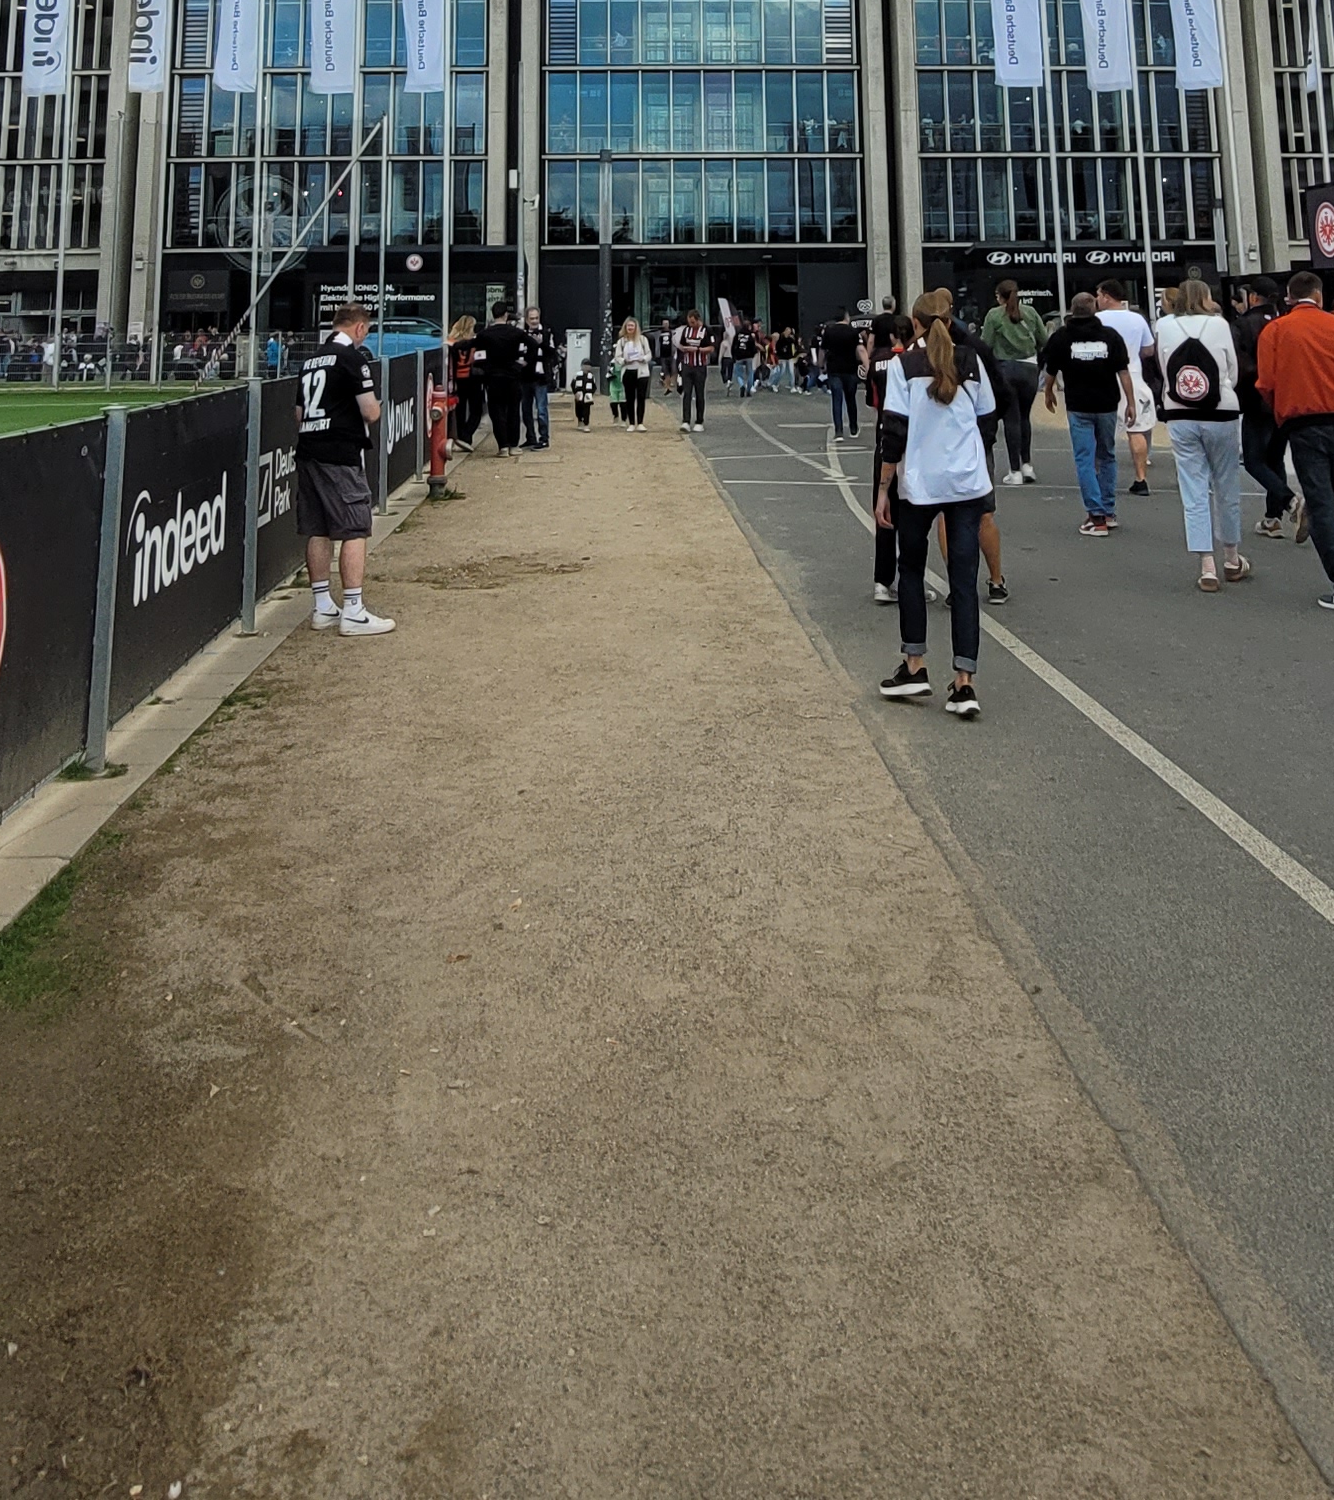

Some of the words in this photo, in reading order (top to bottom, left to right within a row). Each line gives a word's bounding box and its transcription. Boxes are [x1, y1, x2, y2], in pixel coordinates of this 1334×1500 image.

[354, 284, 379, 293] IONIQ
[301, 369, 327, 419] 12
[395, 397, 414, 443] DVAG
[275, 445, 297, 480] Deuts
[274, 480, 291, 519] Park
[133, 471, 227, 607] indeed
